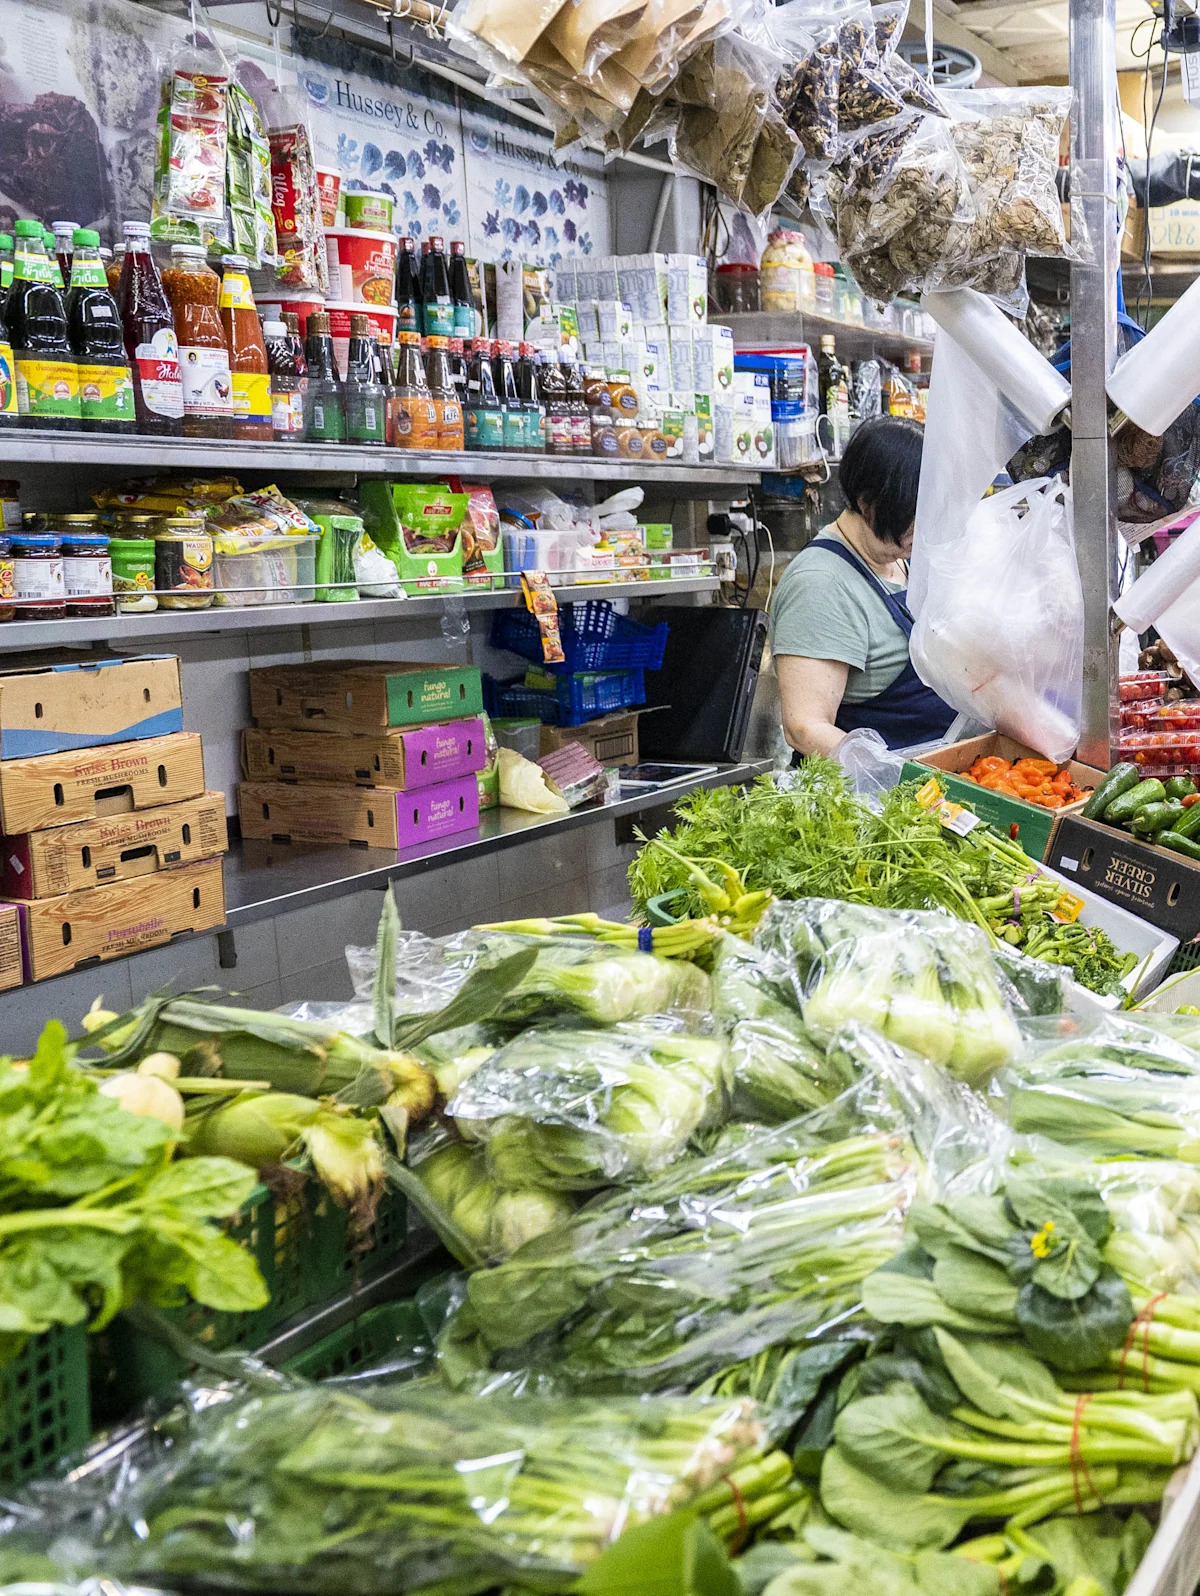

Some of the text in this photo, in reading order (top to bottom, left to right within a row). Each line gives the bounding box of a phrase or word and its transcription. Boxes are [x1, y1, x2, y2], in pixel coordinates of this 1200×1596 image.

[334, 79, 403, 128] Hussey
[405, 102, 420, 130] &
[423, 109, 448, 139] Co.
[494, 130, 545, 171] Hussey
[421, 687, 451, 701] natural
[423, 680, 447, 693] fungo
[436, 737, 456, 749] fungo
[433, 744, 460, 759] natural
[74, 756, 148, 777] Swiss Brown
[102, 768, 149, 782] MUSHROOMS
[430, 799, 451, 812] fungo
[427, 806, 454, 822] natural
[99, 816, 171, 839] Swiss Brown
[1108, 856, 1156, 884] CREEK
[1105, 869, 1152, 898] SILVER
